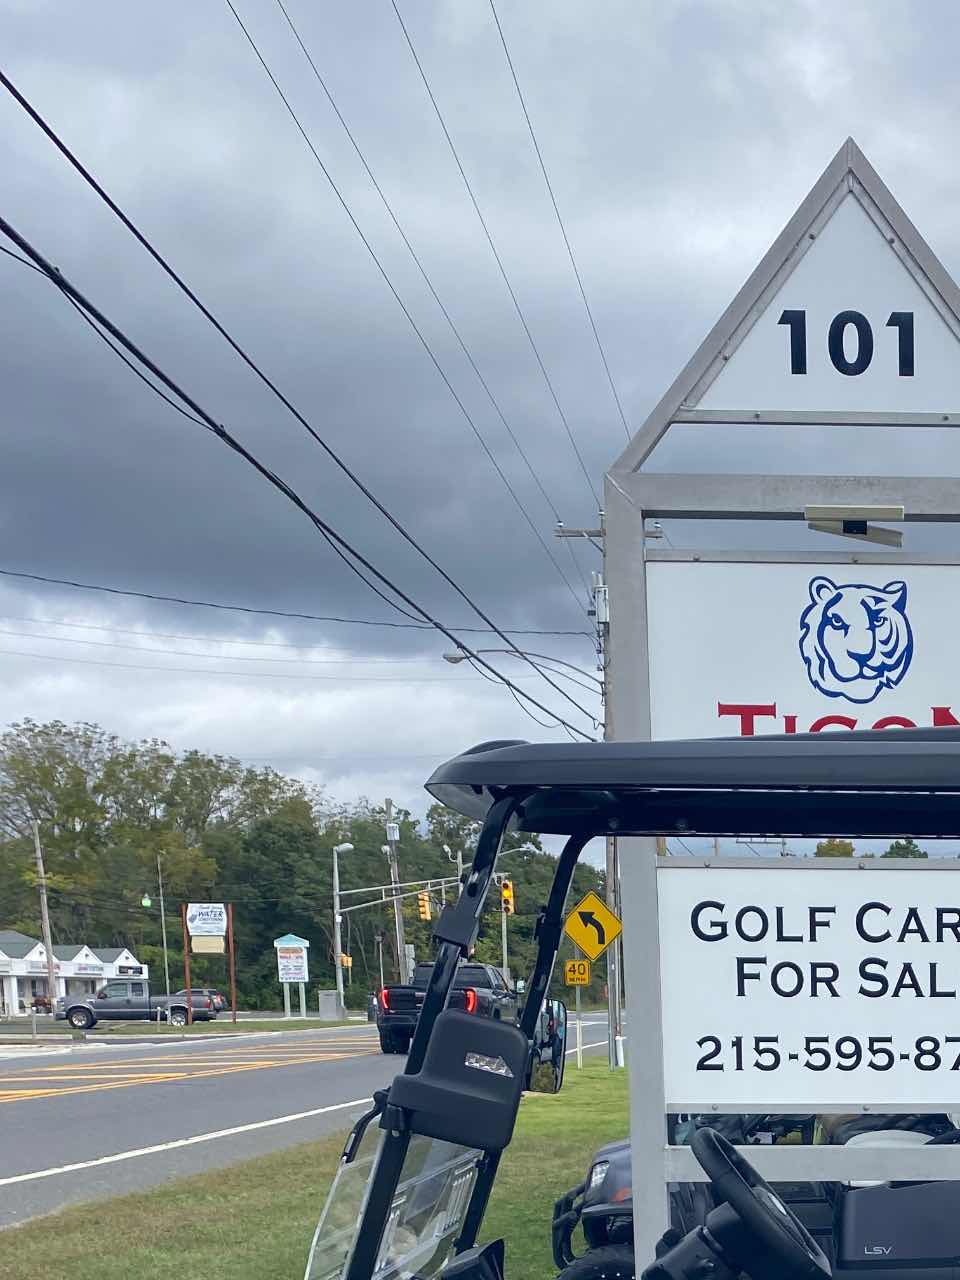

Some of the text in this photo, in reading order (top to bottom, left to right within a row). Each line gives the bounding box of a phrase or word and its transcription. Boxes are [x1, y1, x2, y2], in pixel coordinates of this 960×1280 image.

[777, 309, 915, 377] 101
[690, 900, 836, 943] GOLF
[568, 963, 585, 975] 40
[736, 956, 840, 998] FOR
[864, 1246, 892, 1255] LSV
